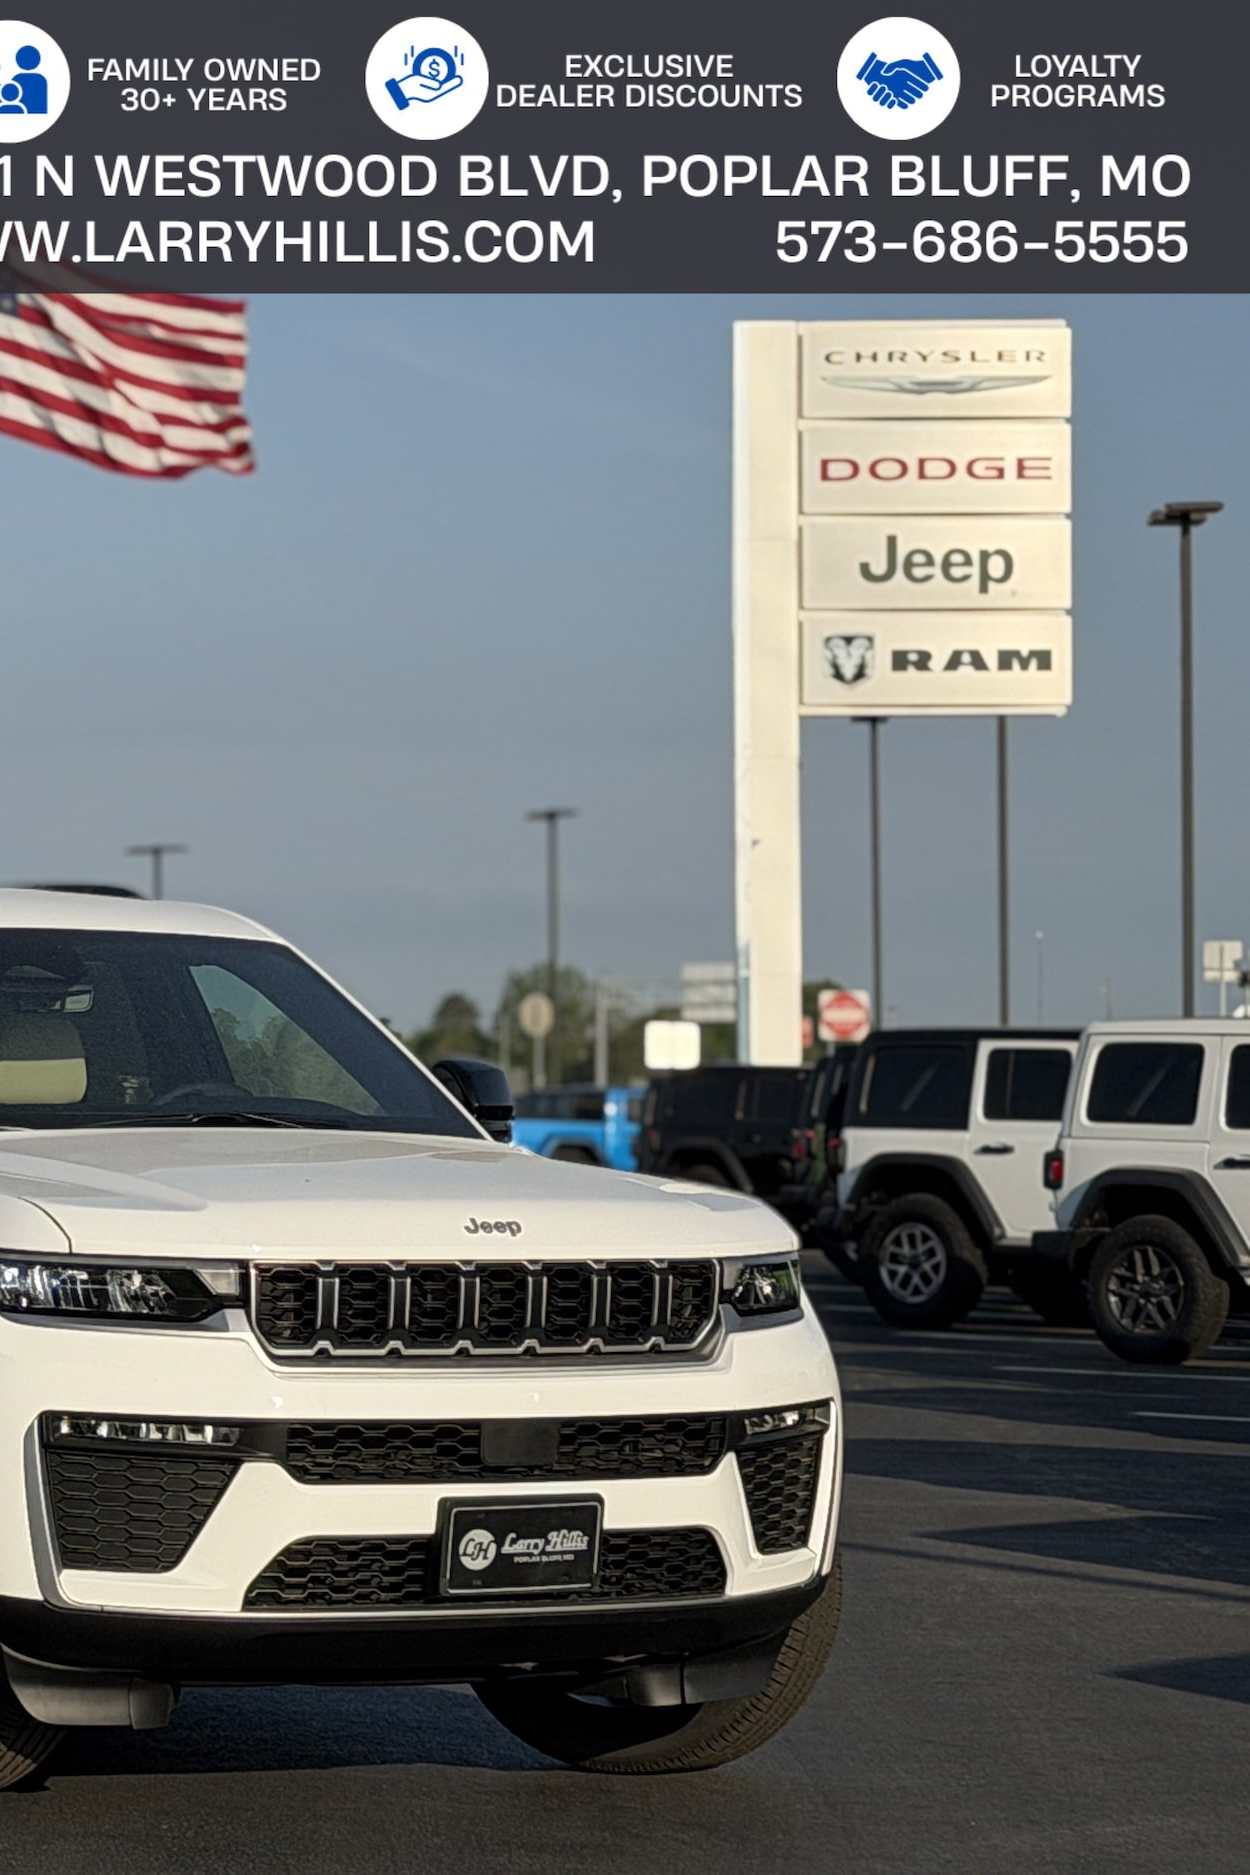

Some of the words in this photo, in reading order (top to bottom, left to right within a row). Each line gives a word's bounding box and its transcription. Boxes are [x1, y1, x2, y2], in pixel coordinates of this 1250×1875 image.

[823, 349, 1047, 366] CHRYSLER
[819, 456, 1053, 482] DODGE
[858, 534, 1015, 594] Jeep
[890, 648, 1053, 673] RAM
[463, 1217, 522, 1237] Jeep
[500, 1532, 545, 1555] Larry
[545, 1529, 590, 1552] Hillis
